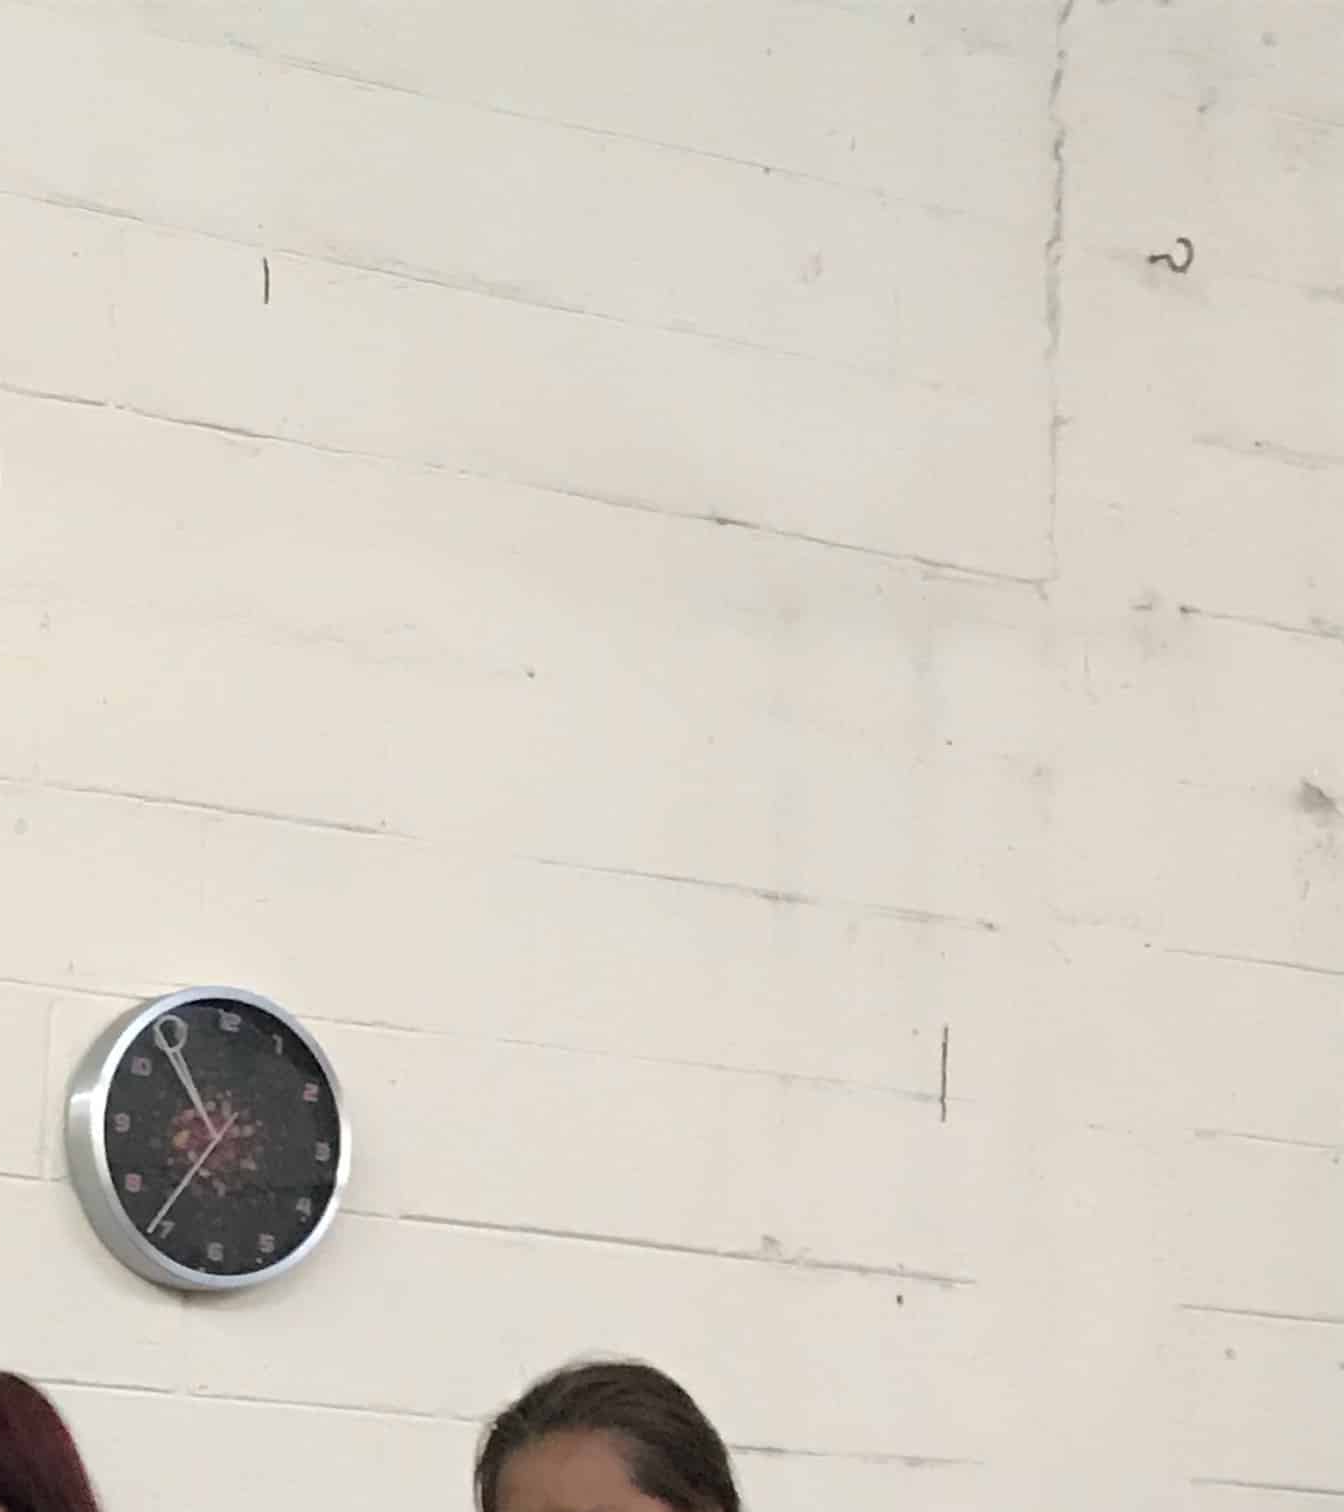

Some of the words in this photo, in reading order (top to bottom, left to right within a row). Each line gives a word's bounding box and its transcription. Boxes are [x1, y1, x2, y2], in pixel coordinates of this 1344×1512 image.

[273, 1033, 284, 1056] 1
[303, 1082, 319, 1102] 2
[115, 1112, 130, 1133] 9
[315, 1141, 331, 1163] 3
[125, 1172, 143, 1193] 8
[295, 1197, 311, 1216] 4
[160, 1220, 175, 1239] 7
[207, 1241, 224, 1262] 6
[258, 1233, 275, 1253] 5
